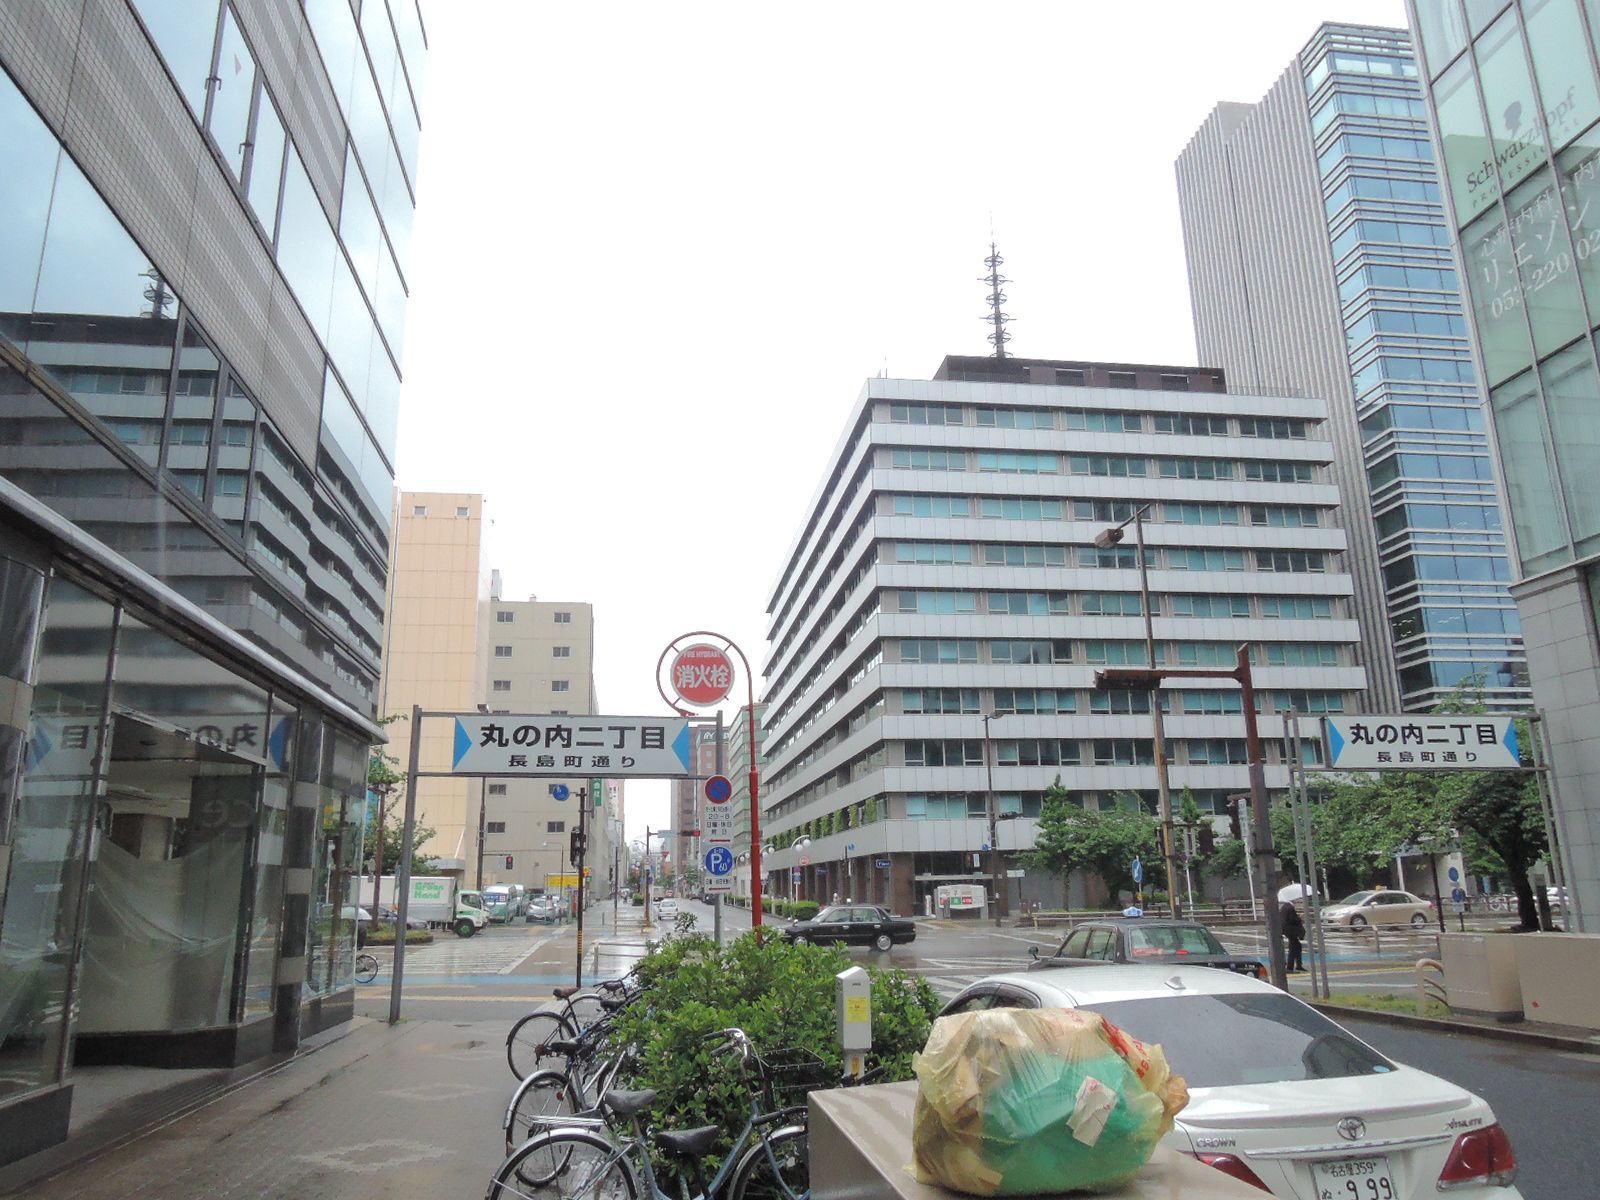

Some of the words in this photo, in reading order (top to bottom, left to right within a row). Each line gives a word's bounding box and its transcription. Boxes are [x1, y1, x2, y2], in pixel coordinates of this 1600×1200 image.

[676, 663, 730, 689] 消火栓
[479, 723, 666, 750] 丸の内二丁目
[1349, 723, 1498, 746] 丸の内二丁目
[508, 754, 635, 768] 長島町通り
[1377, 751, 1477, 763] 長島町通り
[1196, 1136, 1236, 1147] CROWN
